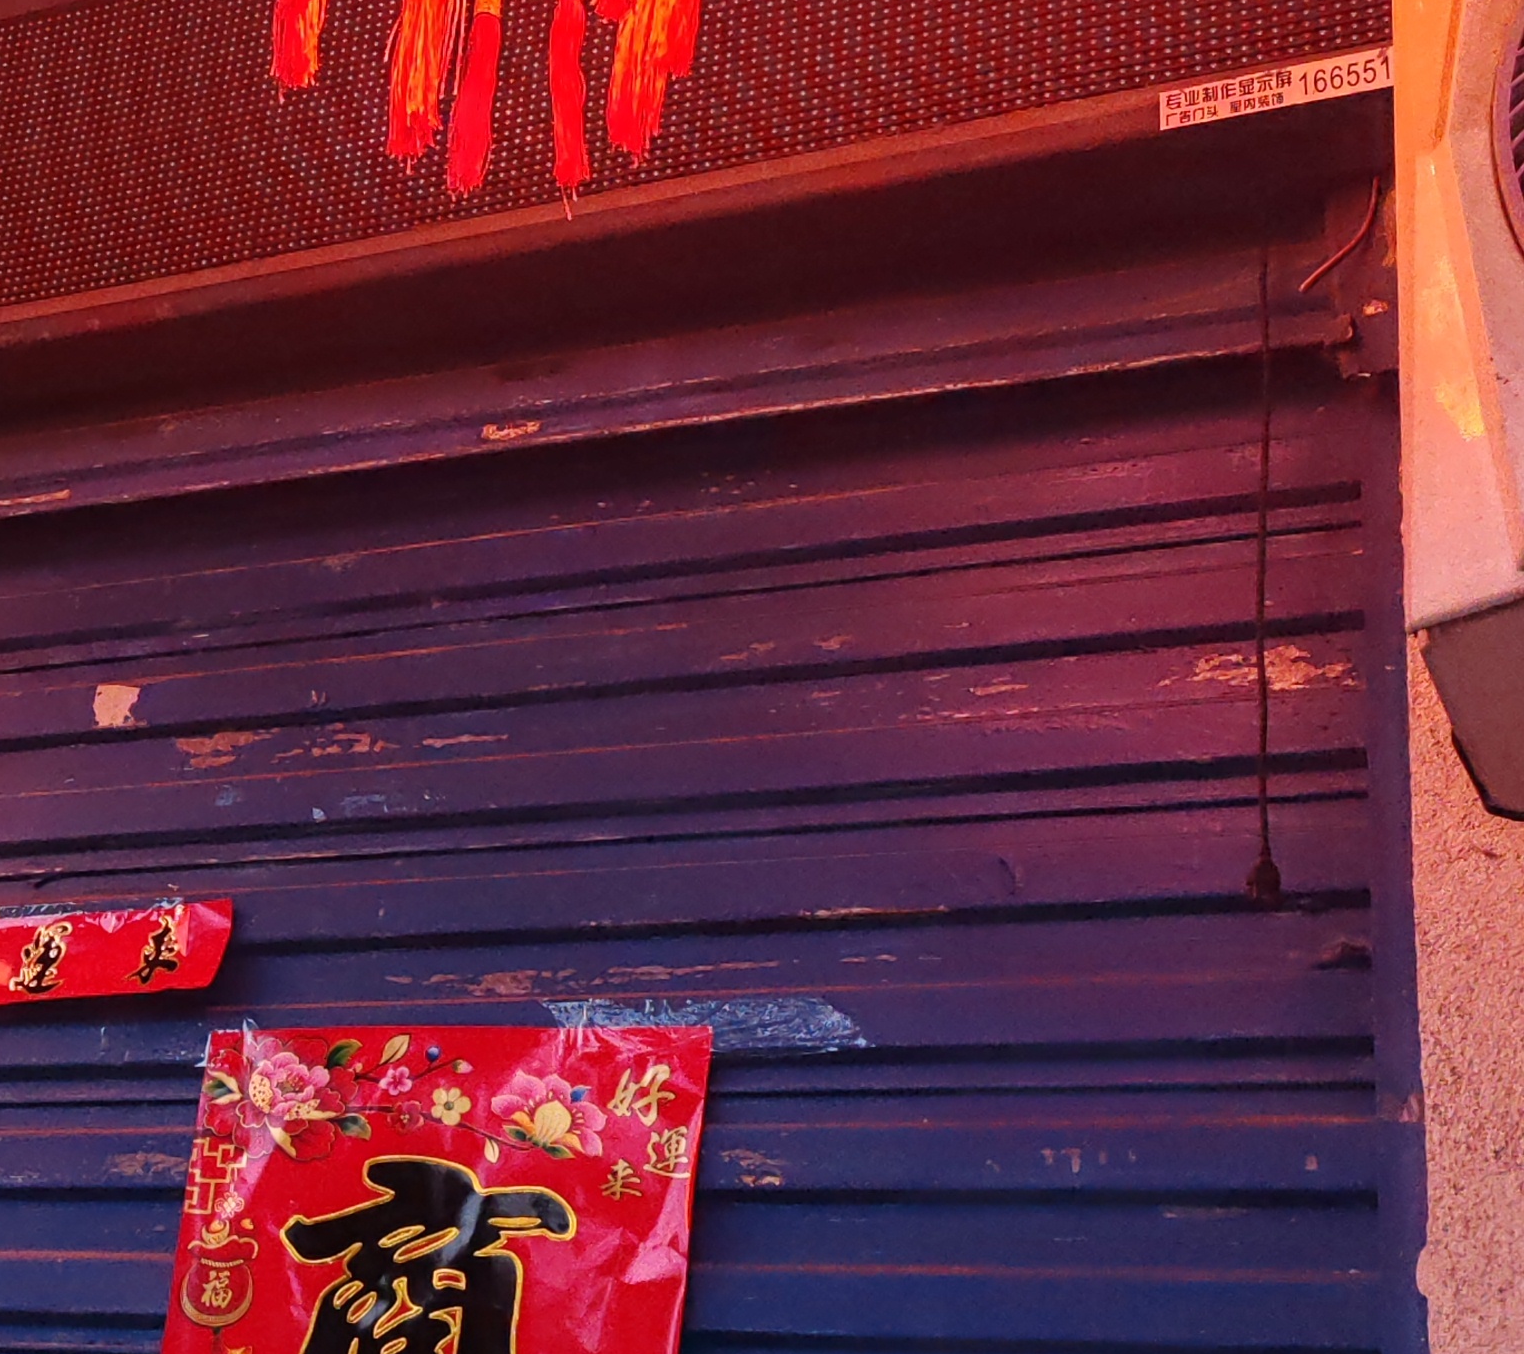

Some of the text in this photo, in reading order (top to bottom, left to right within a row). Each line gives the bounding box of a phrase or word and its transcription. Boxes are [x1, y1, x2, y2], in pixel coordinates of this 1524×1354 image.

[1165, 55, 1391, 110] 专业制作显示屏 166551
[1166, 105, 1219, 126] 广告门头
[200, 1269, 233, 1310] 福
